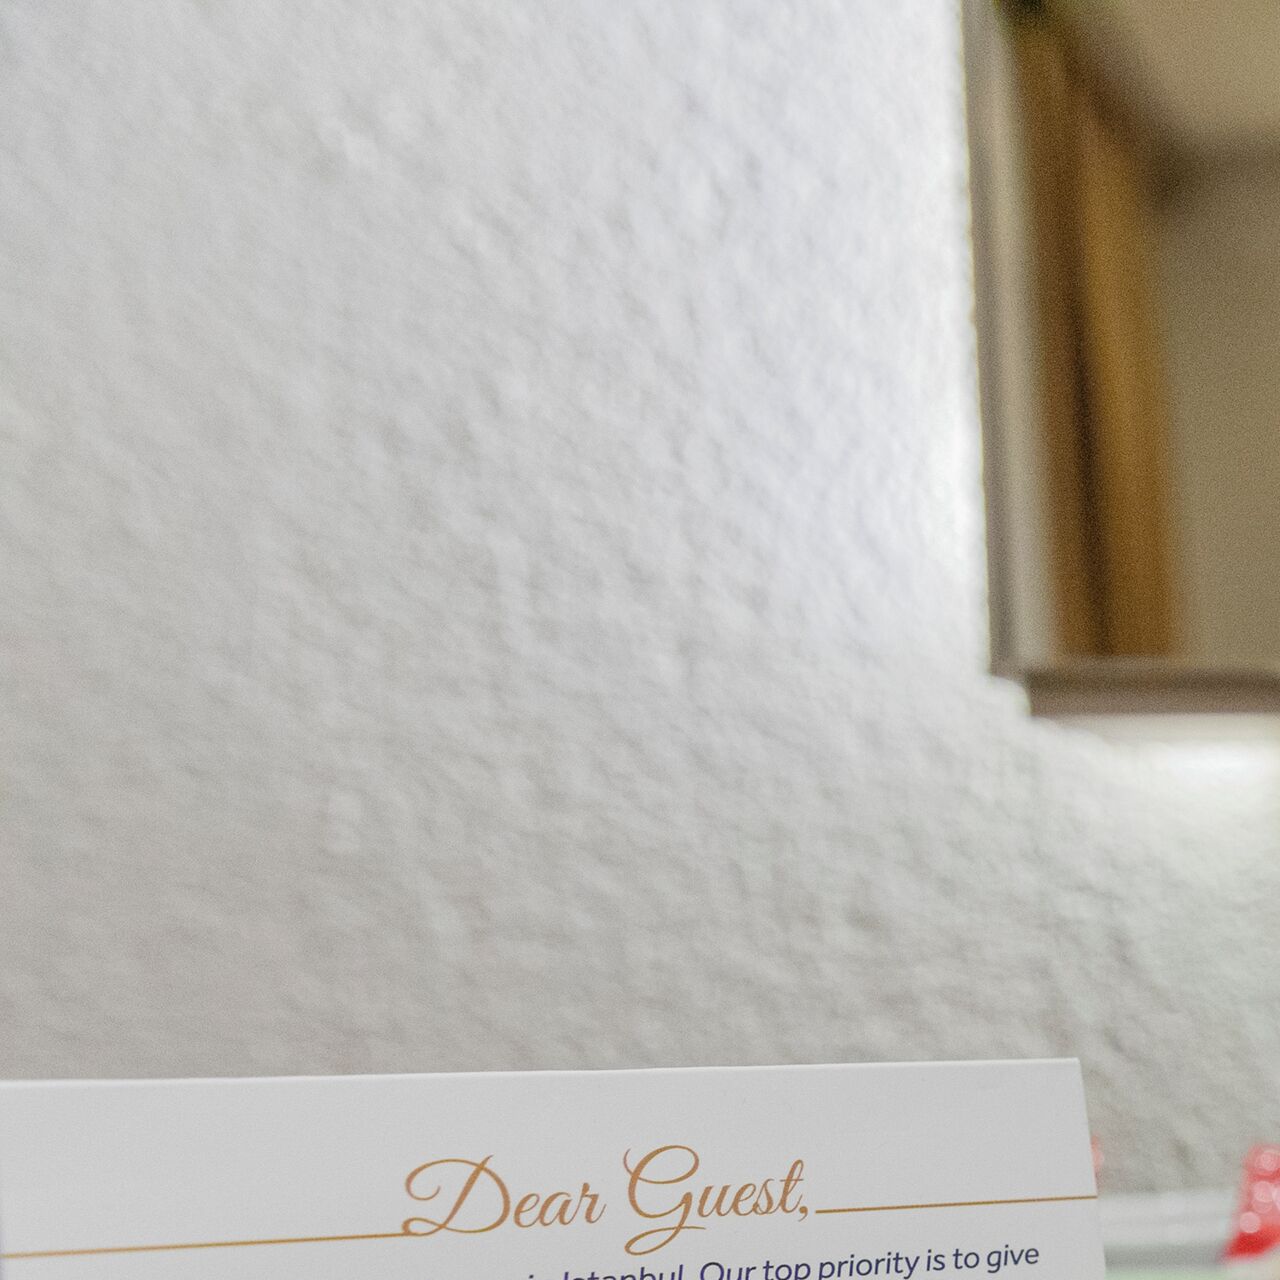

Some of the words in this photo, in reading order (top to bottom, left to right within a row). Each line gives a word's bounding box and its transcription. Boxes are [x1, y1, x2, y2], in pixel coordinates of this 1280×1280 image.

[402, 1155, 605, 1237] Dear
[623, 1145, 808, 1256] Guest,
[926, 1249, 946, 1271] is
[953, 1248, 980, 1270] to
[986, 1244, 1039, 1274] give
